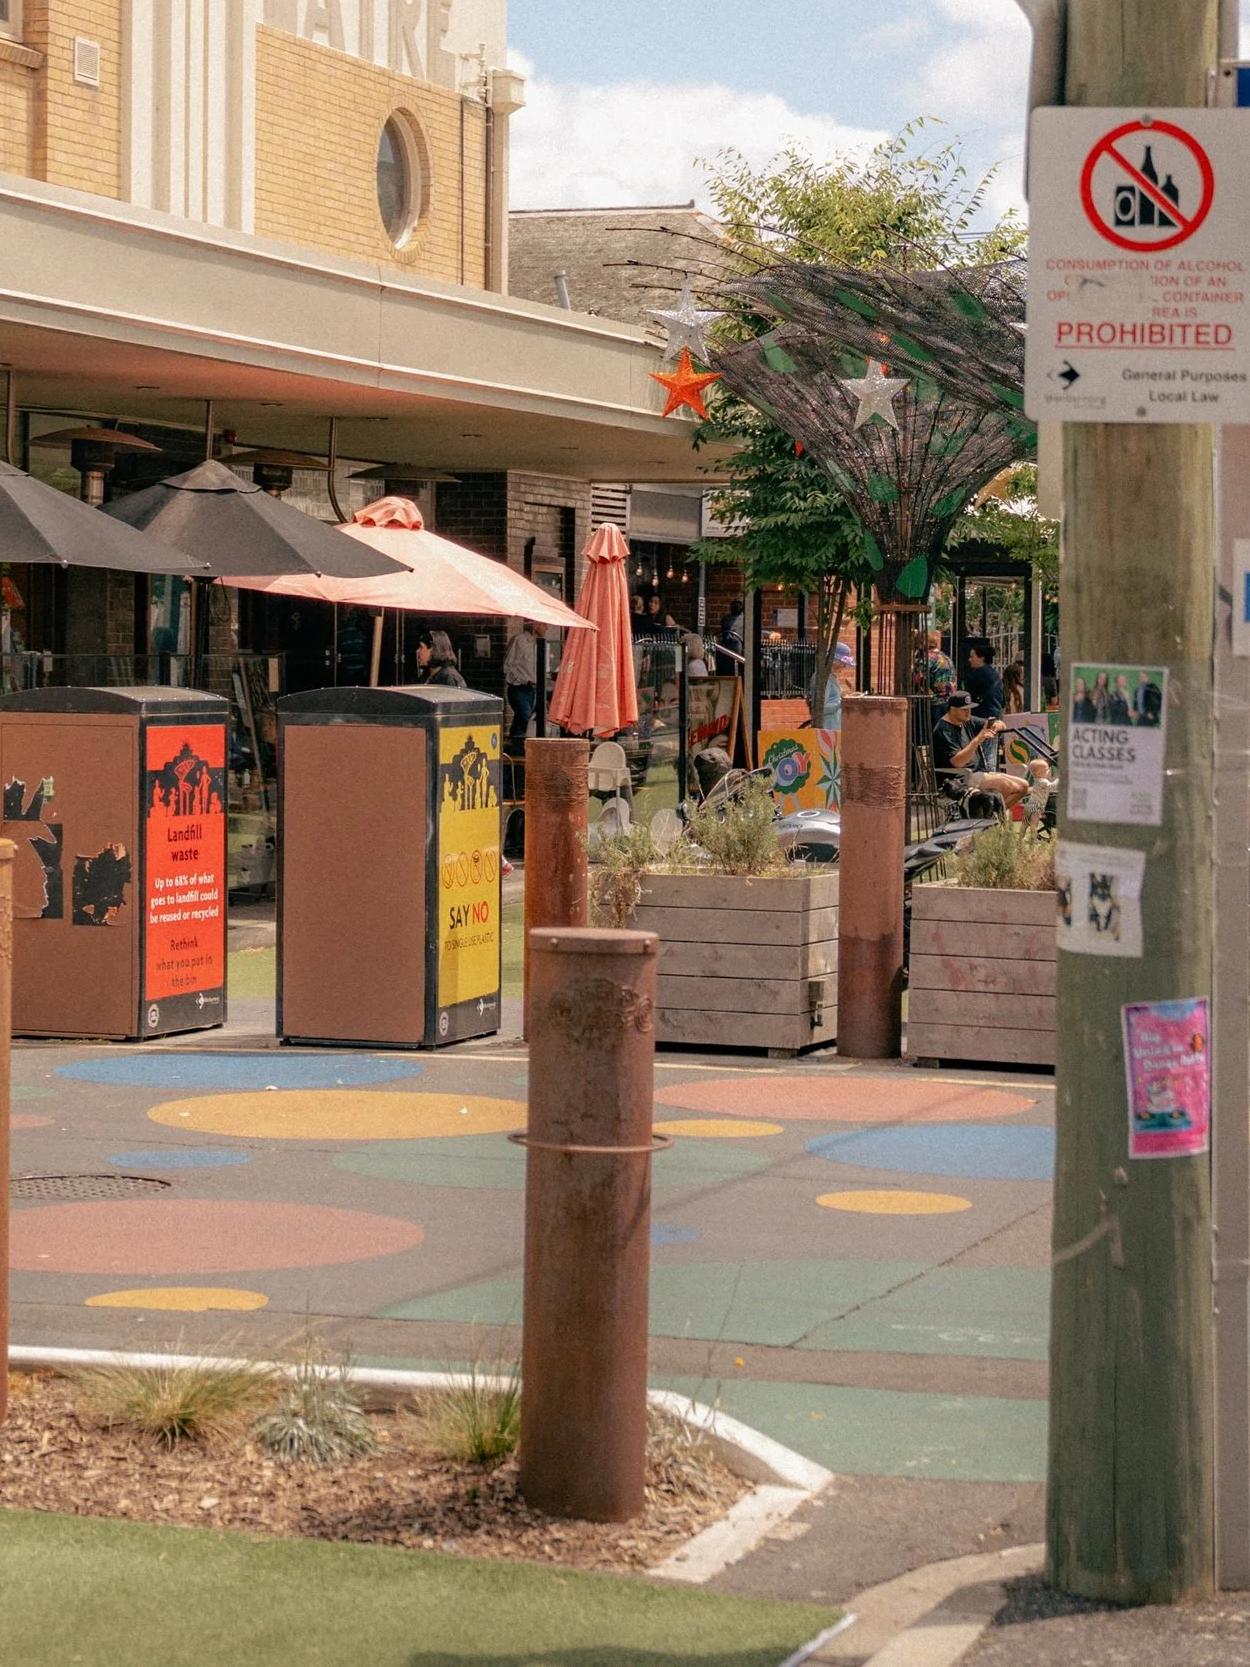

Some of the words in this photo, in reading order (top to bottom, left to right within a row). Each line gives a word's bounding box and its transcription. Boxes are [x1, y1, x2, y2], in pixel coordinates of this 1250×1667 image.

[1046, 259, 1149, 271] CONSUMPTION
[1154, 260, 1171, 271] OF
[1177, 261, 1244, 273] ALCOHOL
[1184, 276, 1202, 287] OF
[1208, 276, 1226, 287] AN
[1162, 291, 1244, 304] CONTAINER
[1151, 306, 1180, 318] REA
[1185, 307, 1198, 318] IS
[1057, 322, 1232, 345] PROHIBITED
[1122, 368, 1176, 382] General
[1181, 370, 1247, 384] Purposes
[1149, 391, 1187, 403] Local
[1192, 392, 1219, 403] Law
[1073, 728, 1129, 744] ACTING
[1072, 744, 1136, 762] CLASSES
[776, 751, 811, 786] OY
[167, 824, 202, 842] Landfill
[171, 849, 199, 861] waste
[155, 878, 164, 891] Up
[165, 877, 174, 888] to
[174, 875, 189, 887] 68%
[189, 873, 198, 885] of
[198, 872, 215, 885] what
[150, 897, 166, 910] goes
[167, 894, 175, 905] to
[175, 890, 199, 903] landfill
[200, 888, 219, 901] could
[150, 911, 159, 924] be
[160, 908, 182, 922] reused
[182, 911, 191, 920] or
[191, 905, 219, 922] recycled
[449, 904, 470, 929] SAY
[472, 901, 489, 925] NO
[170, 936, 199, 950] Rethink
[476, 932, 494, 945] PLASTIC
[176, 959, 190, 972] you
[191, 956, 204, 971] put
[205, 953, 213, 966] in
